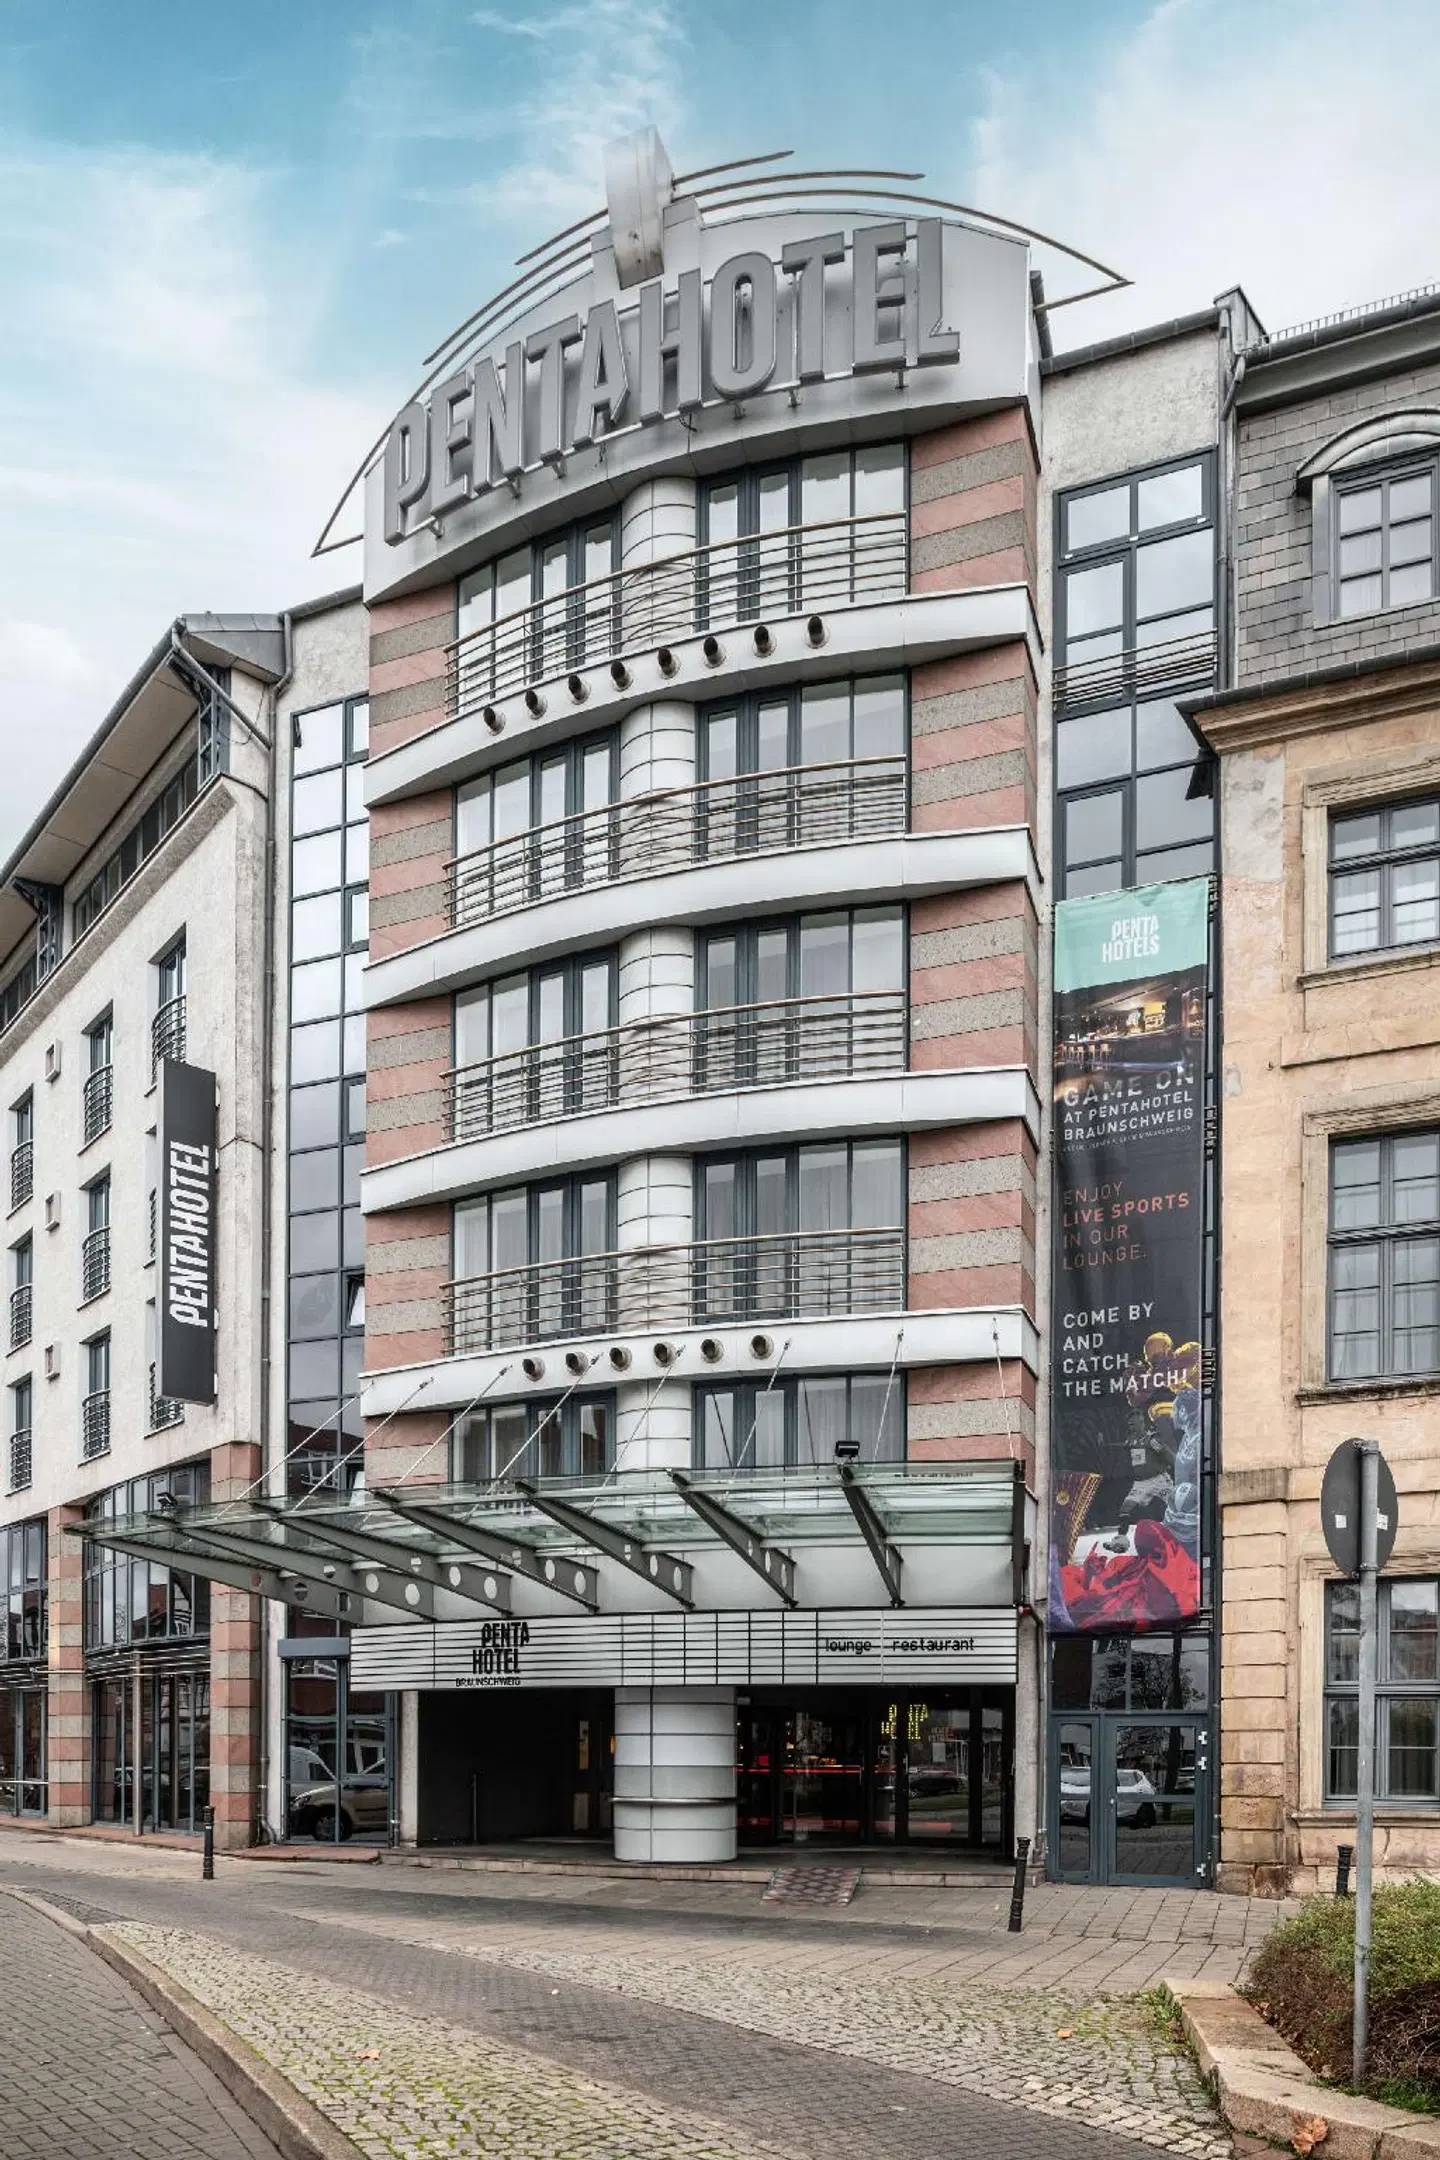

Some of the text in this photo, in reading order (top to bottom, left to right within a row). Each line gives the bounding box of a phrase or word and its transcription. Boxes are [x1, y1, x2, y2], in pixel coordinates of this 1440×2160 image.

[384, 217, 960, 546] PENTAHOTEL
[1111, 914, 1159, 941] PENTA
[1102, 934, 1160, 963] HOTELS
[1064, 1063, 1194, 1107] GAME ON
[1064, 1090, 1193, 1124] AT PENTAHOTEL
[1064, 1107, 1194, 1141] BRAUNSCHWEIG
[1064, 1182, 1122, 1205] ENJOY
[1063, 1192, 1190, 1228] LIVE SPORTS
[169, 1140, 210, 1329] PENTAHOTEL
[1064, 1224, 1128, 1249] IN OUR
[1063, 1302, 1154, 1329] COME BY
[1063, 1333, 1104, 1351] AND
[1063, 1353, 1129, 1374] CATCH
[1063, 1368, 1187, 1397] THE MATCH!
[481, 1621, 530, 1649] PENTA
[825, 1637, 975, 1655] lounge restaurant
[472, 1648, 521, 1675] HOTEL
